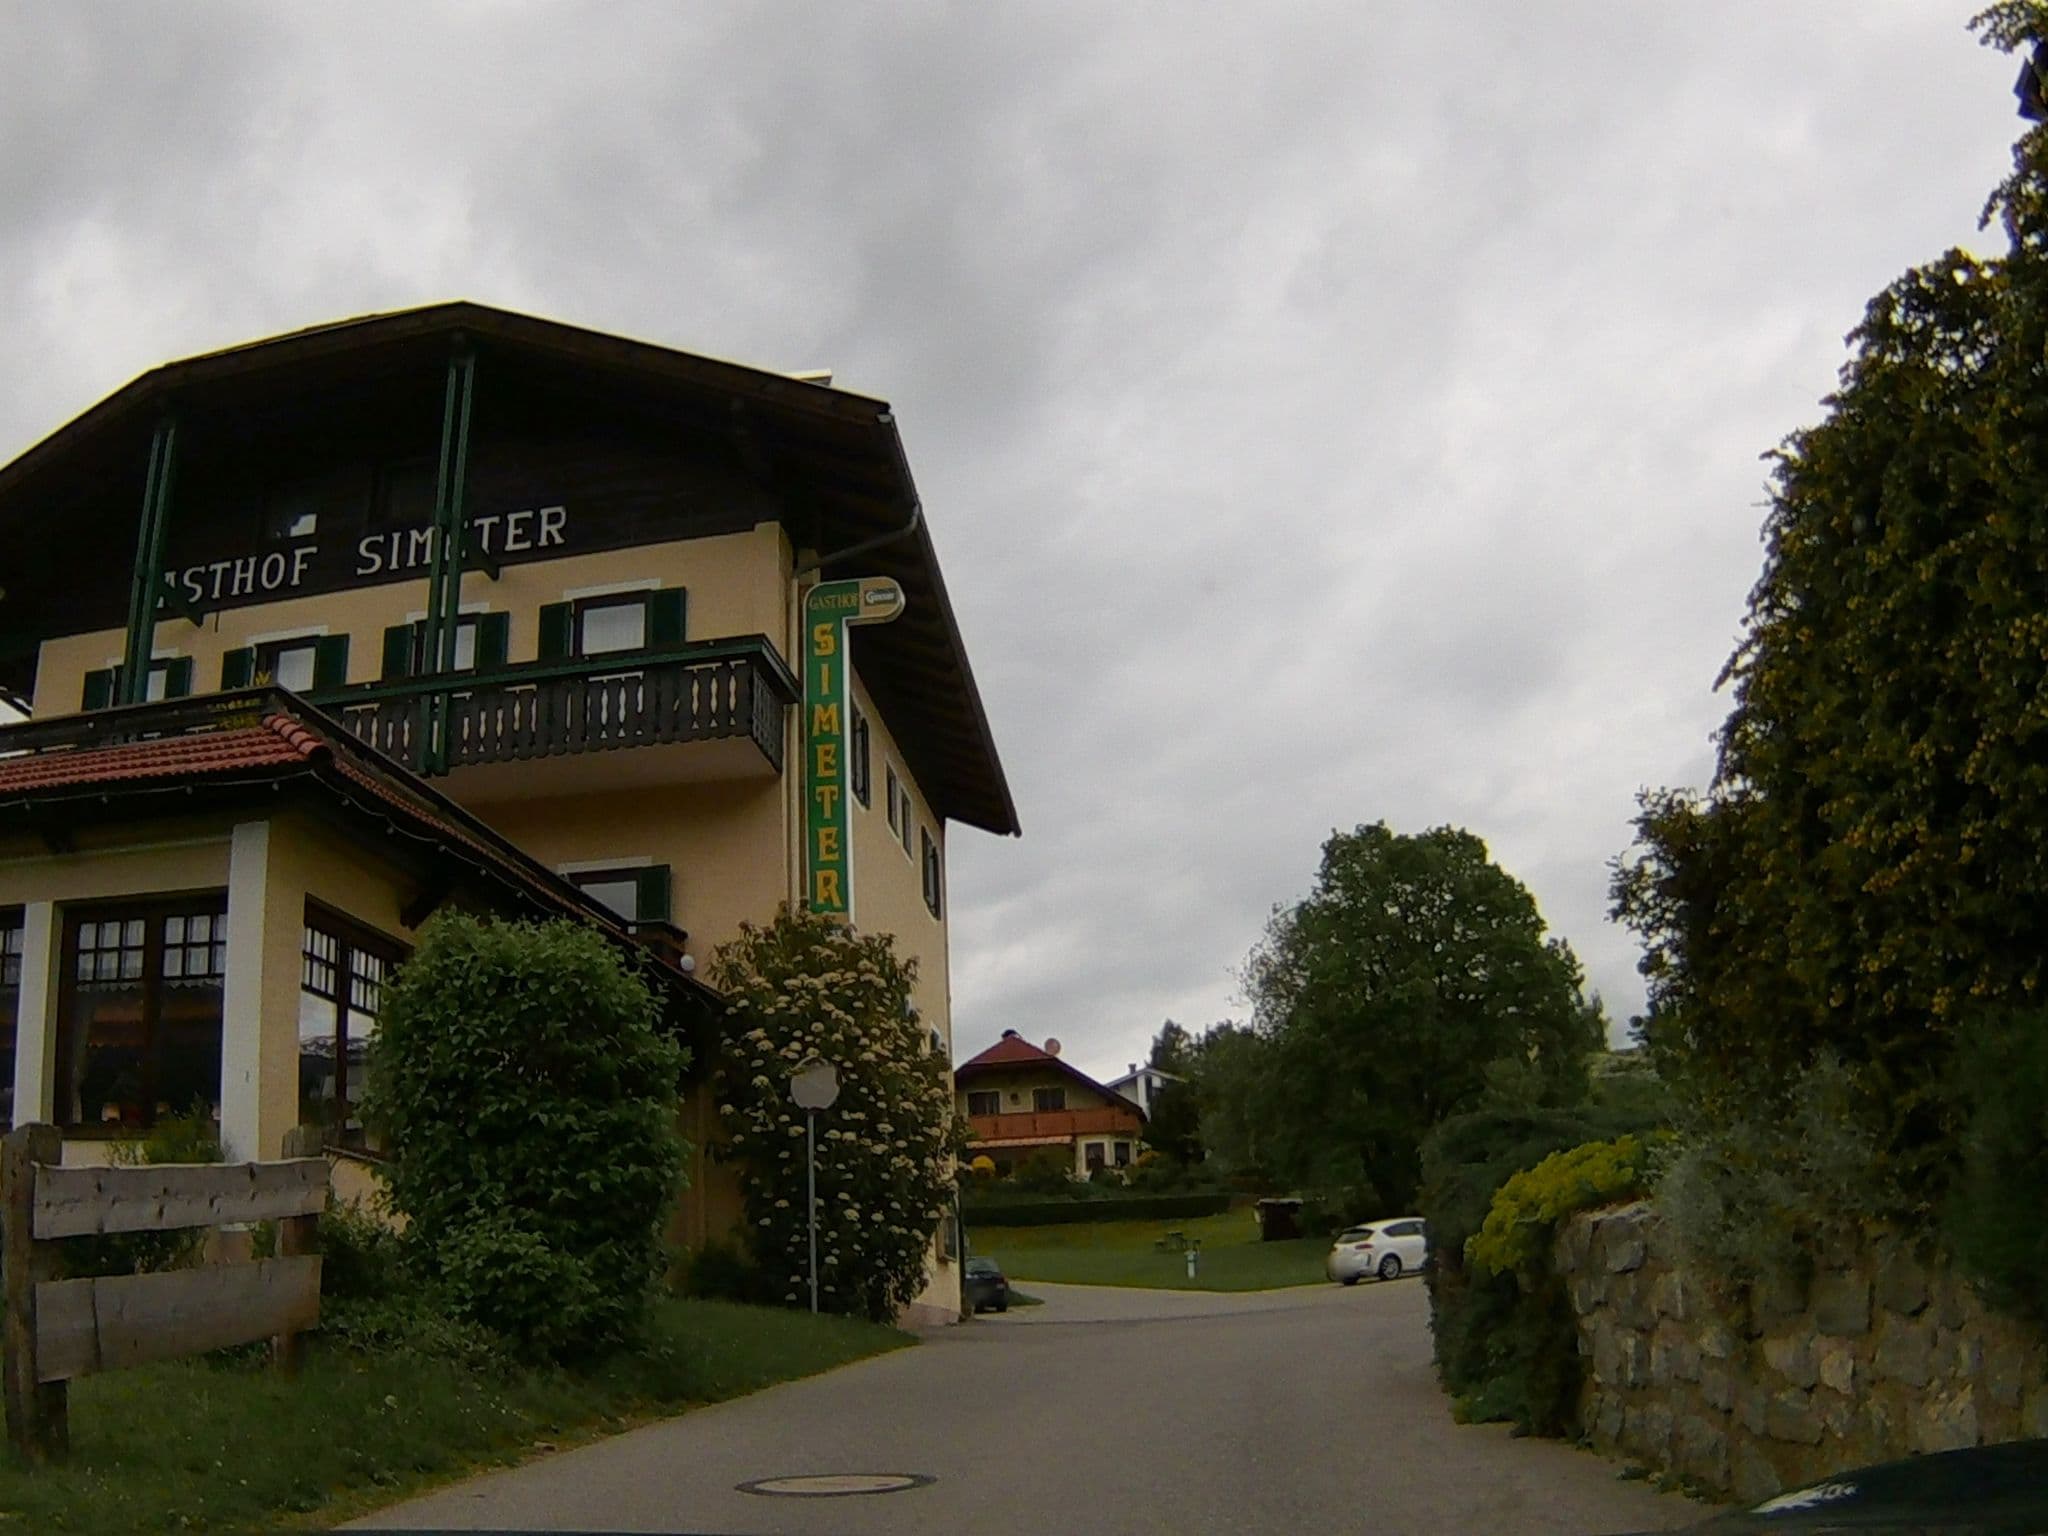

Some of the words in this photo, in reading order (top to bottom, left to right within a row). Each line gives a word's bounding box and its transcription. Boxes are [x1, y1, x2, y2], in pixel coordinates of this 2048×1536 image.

[157, 546, 318, 608] STHOF
[808, 592, 859, 610] GASTHOF
[812, 623, 842, 907] SIMETER
